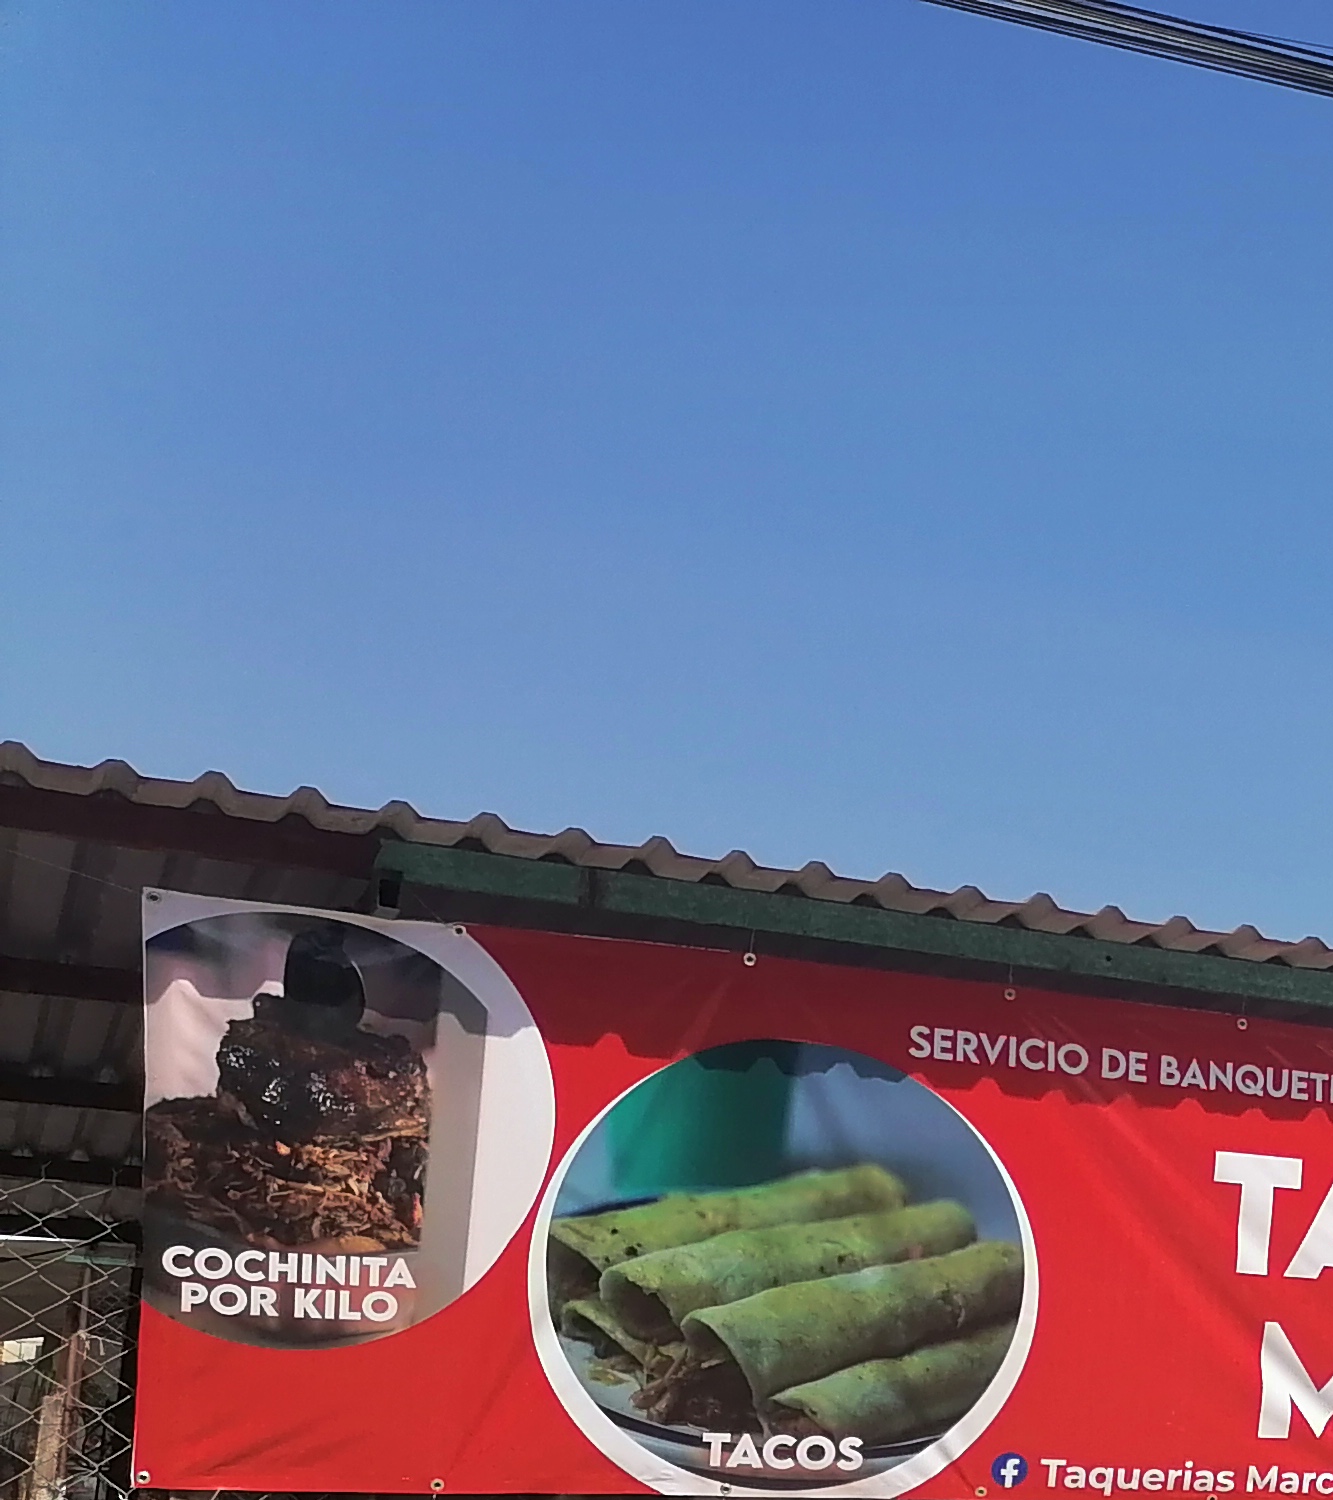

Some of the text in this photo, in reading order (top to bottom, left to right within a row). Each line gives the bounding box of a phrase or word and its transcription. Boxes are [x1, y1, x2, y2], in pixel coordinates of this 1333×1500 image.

[908, 1026, 1088, 1076] SERVICIO
[1102, 1048, 1147, 1082] DE
[163, 1246, 416, 1290] COCHINITA
[181, 1283, 398, 1322] POR KILO
[703, 1432, 864, 1472] TACOS
[1041, 1459, 1235, 1500] Taquerias
